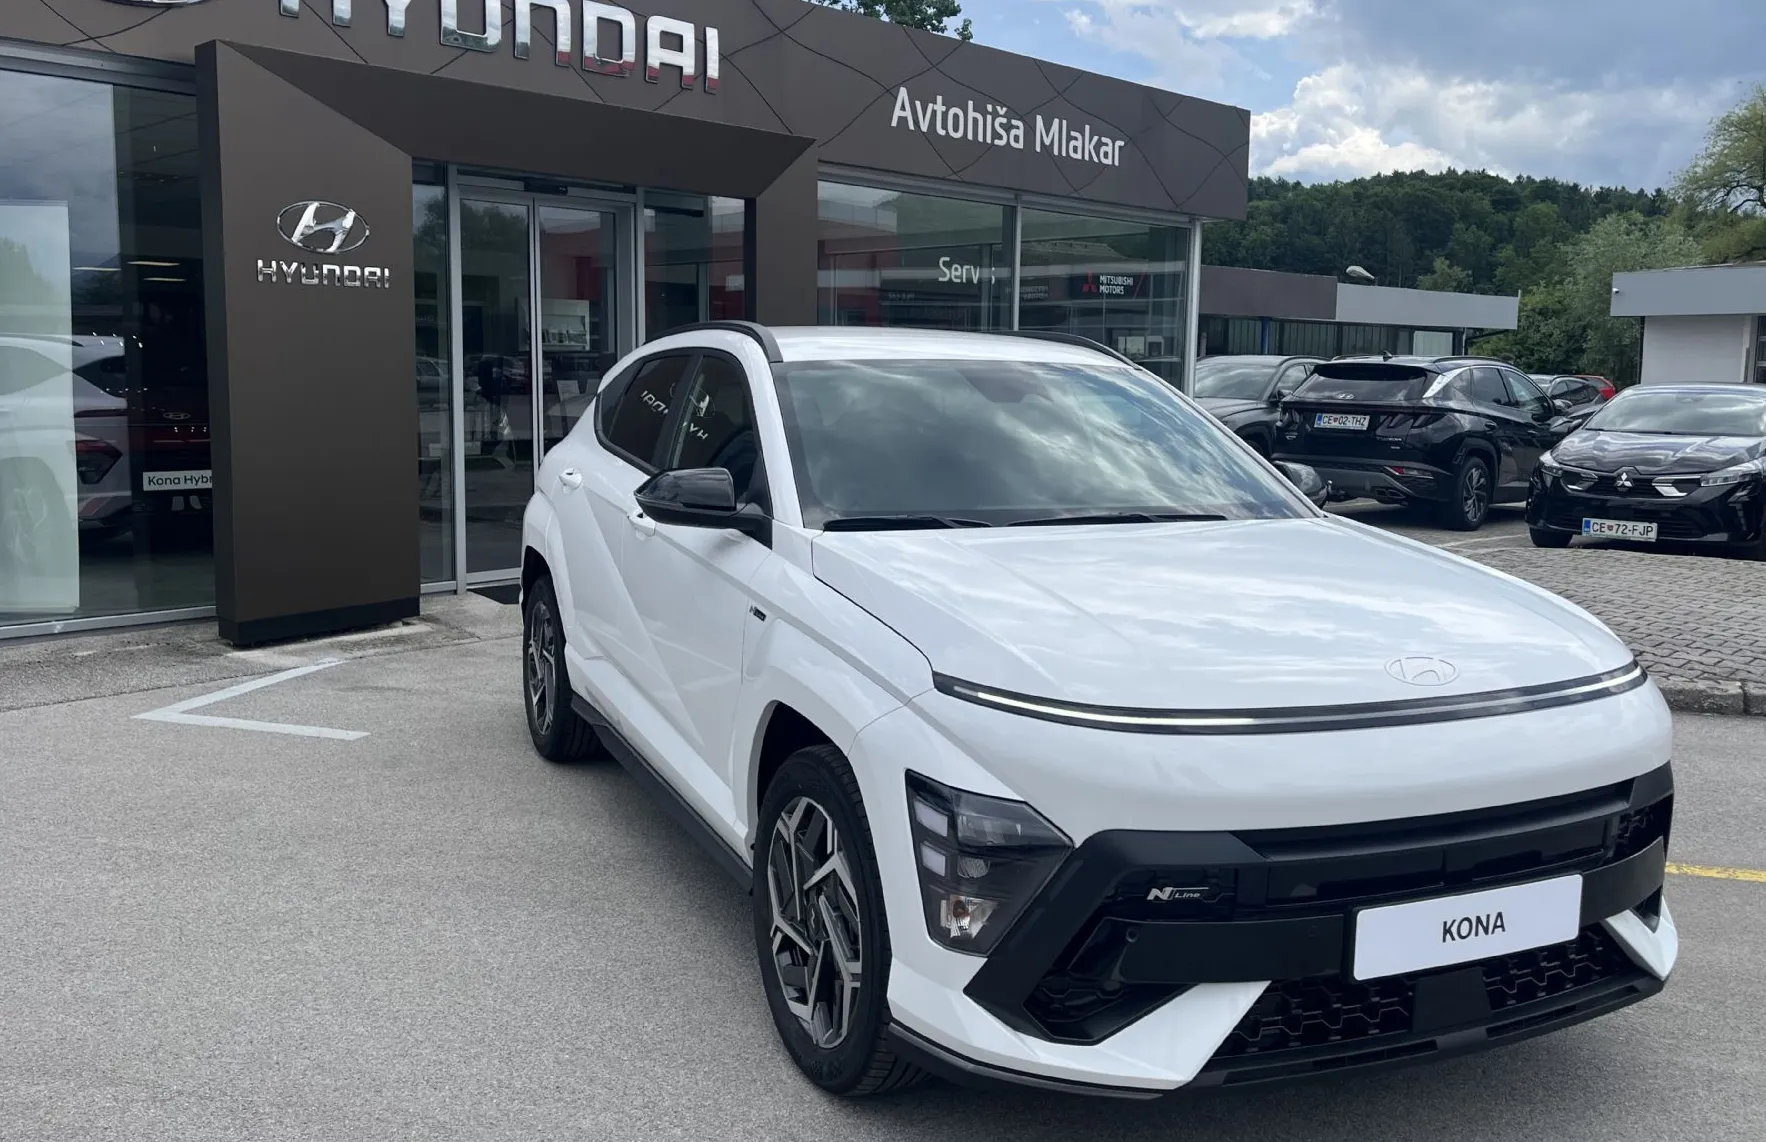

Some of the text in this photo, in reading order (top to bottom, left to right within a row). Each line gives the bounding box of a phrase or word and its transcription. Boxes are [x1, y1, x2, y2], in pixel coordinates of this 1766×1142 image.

[279, 0, 720, 94] UNDAI
[890, 86, 1125, 167] Avtohiša Mlakar
[257, 259, 390, 288] HYUNDAI
[1099, 275, 1134, 286] MITSUBISHI
[1099, 285, 1125, 295] MOTORS
[1322, 415, 1367, 427] CE 02-THZ
[147, 476, 181, 486] Kona
[1592, 522, 1653, 536] CE 72-FJP
[1442, 911, 1506, 943] KONA
